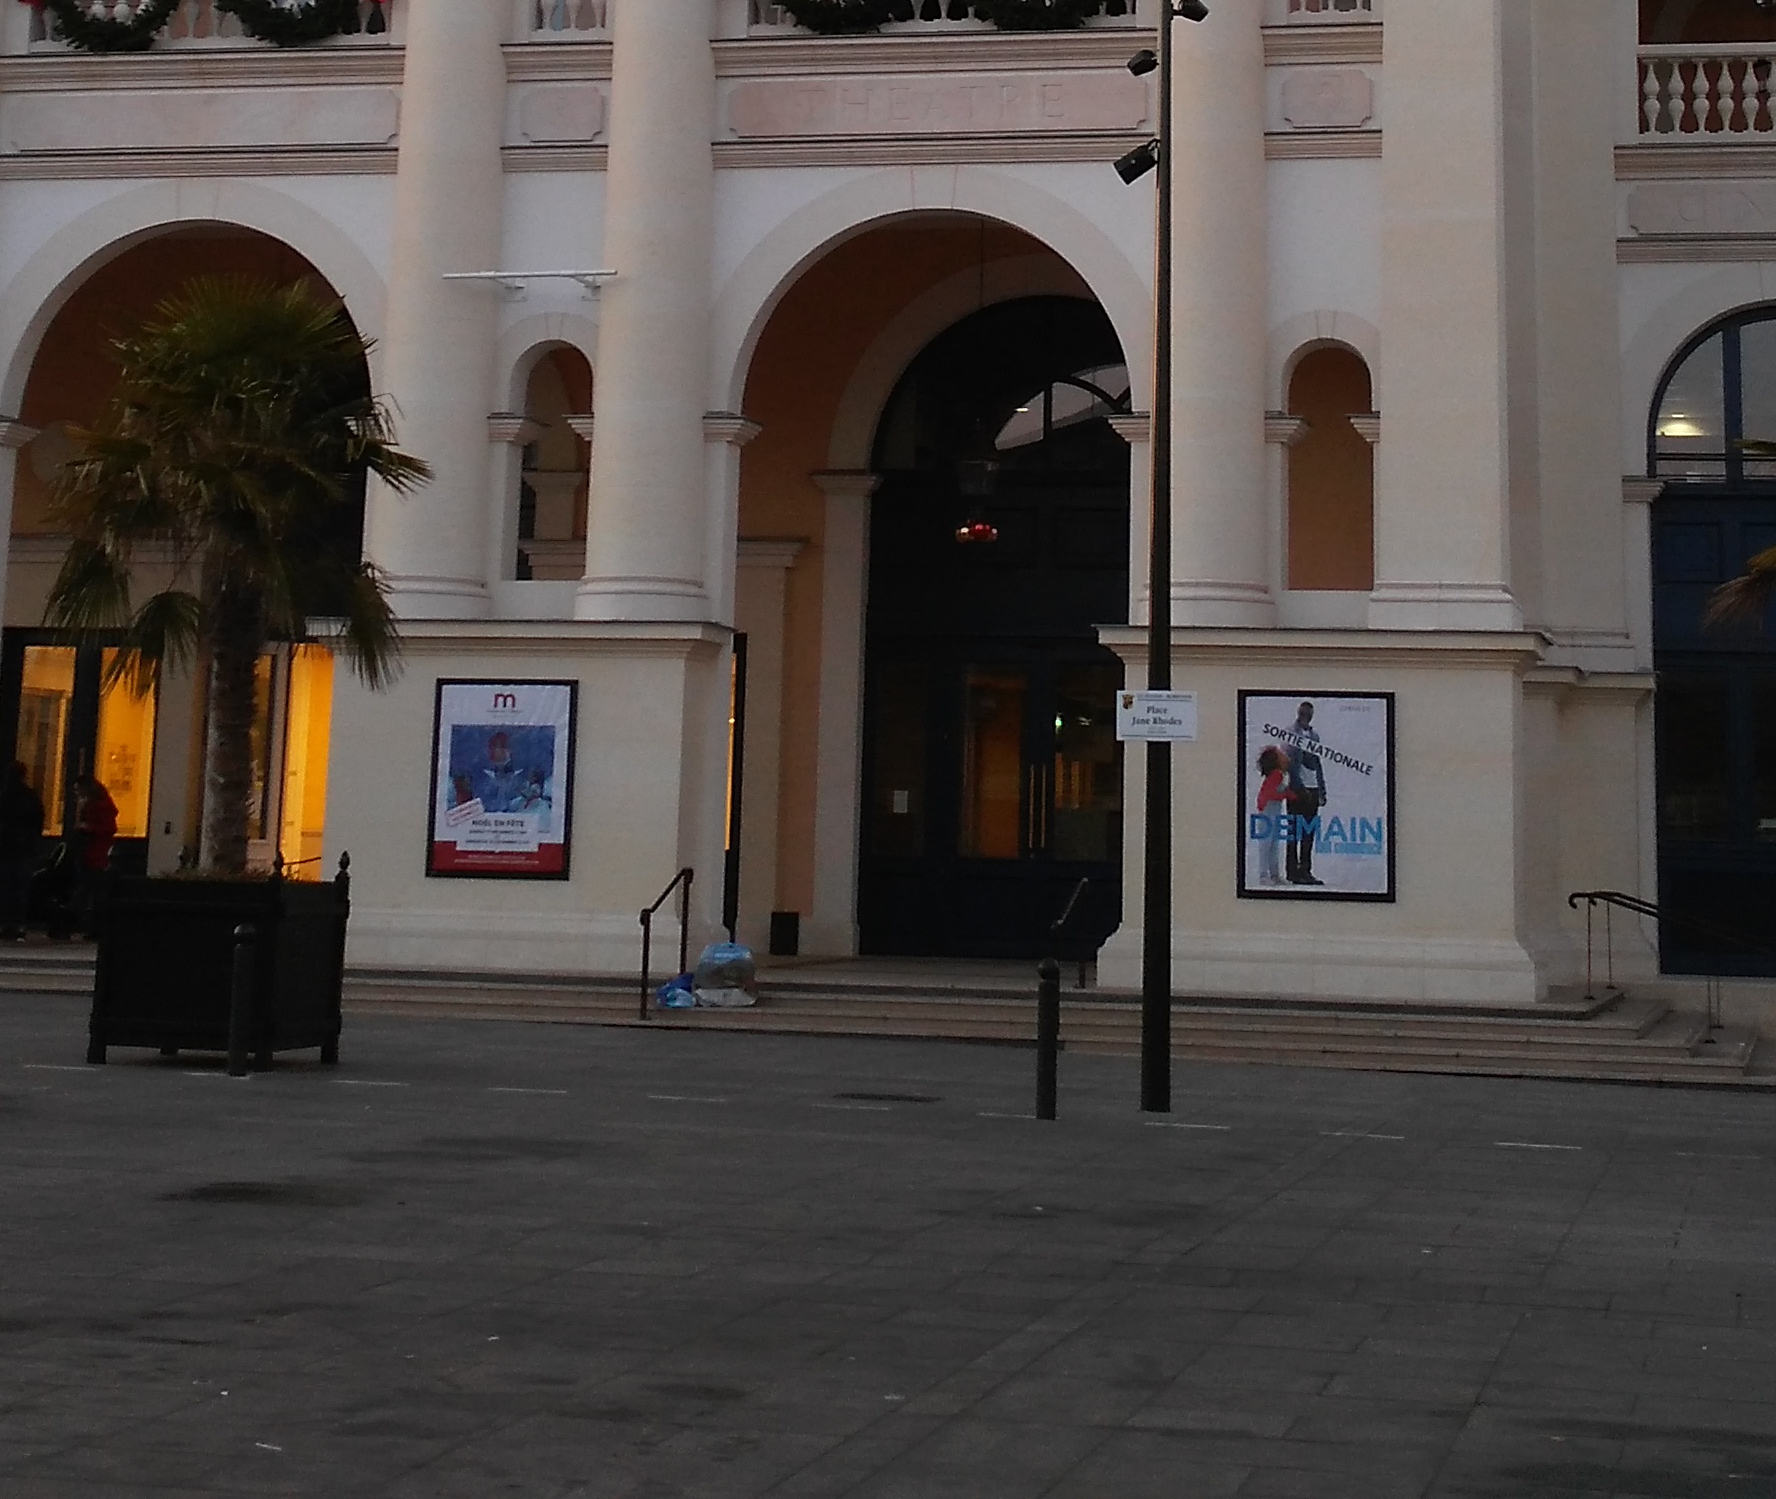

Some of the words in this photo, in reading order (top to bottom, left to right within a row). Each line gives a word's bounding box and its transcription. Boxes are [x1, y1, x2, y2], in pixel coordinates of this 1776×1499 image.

[1146, 705, 1168, 714] Place
[1131, 716, 1150, 726] Jane
[1152, 716, 1183, 725] Rhodes
[1263, 723, 1305, 748] SORTIE
[1306, 742, 1373, 776] NATIONALE
[1249, 813, 1382, 842] DEMAIN
